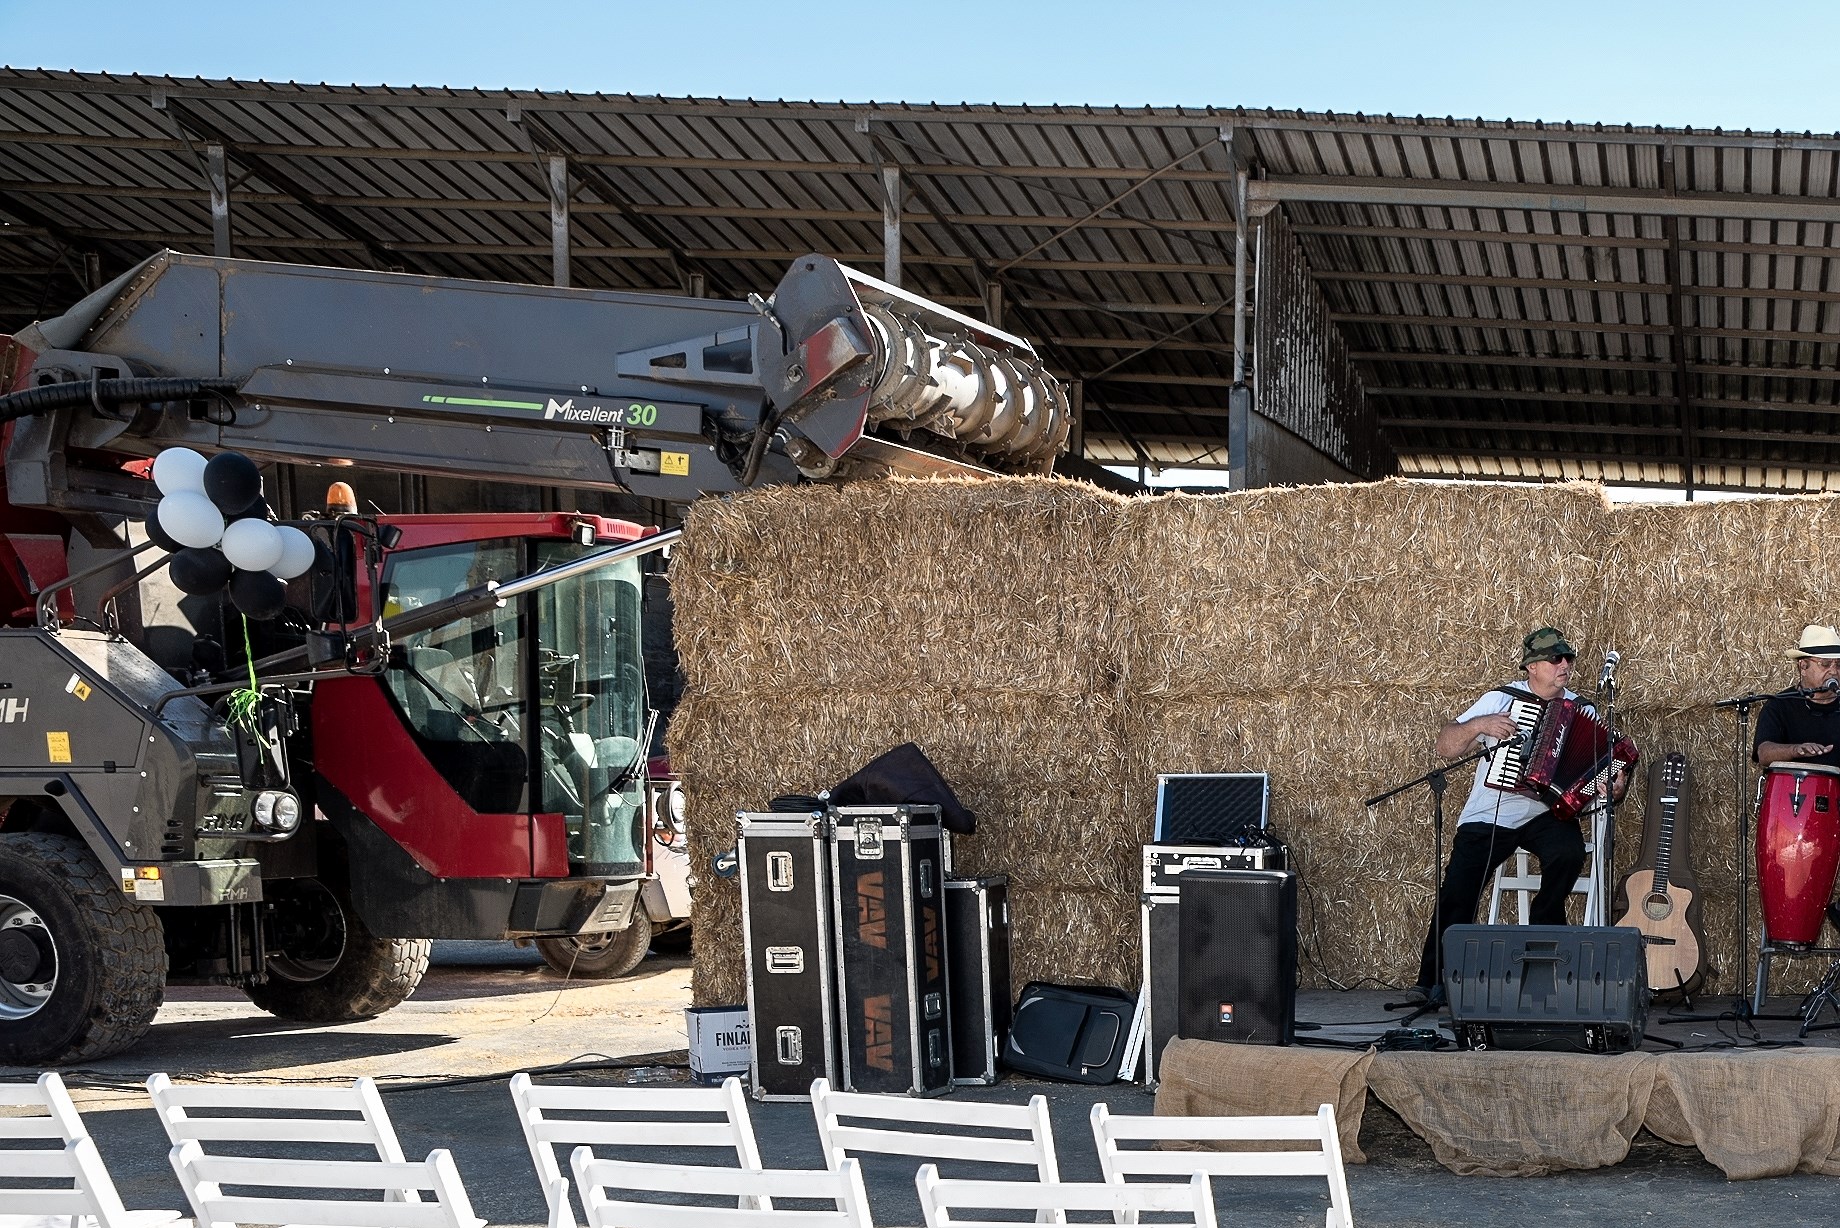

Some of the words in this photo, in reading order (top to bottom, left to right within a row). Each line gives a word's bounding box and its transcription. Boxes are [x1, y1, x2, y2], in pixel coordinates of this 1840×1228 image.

[544, 398, 624, 423] Mixellent
[626, 403, 658, 427] 30
[202, 812, 248, 832] RMH
[218, 887, 249, 901] RMH
[715, 1030, 750, 1047] FINLA
